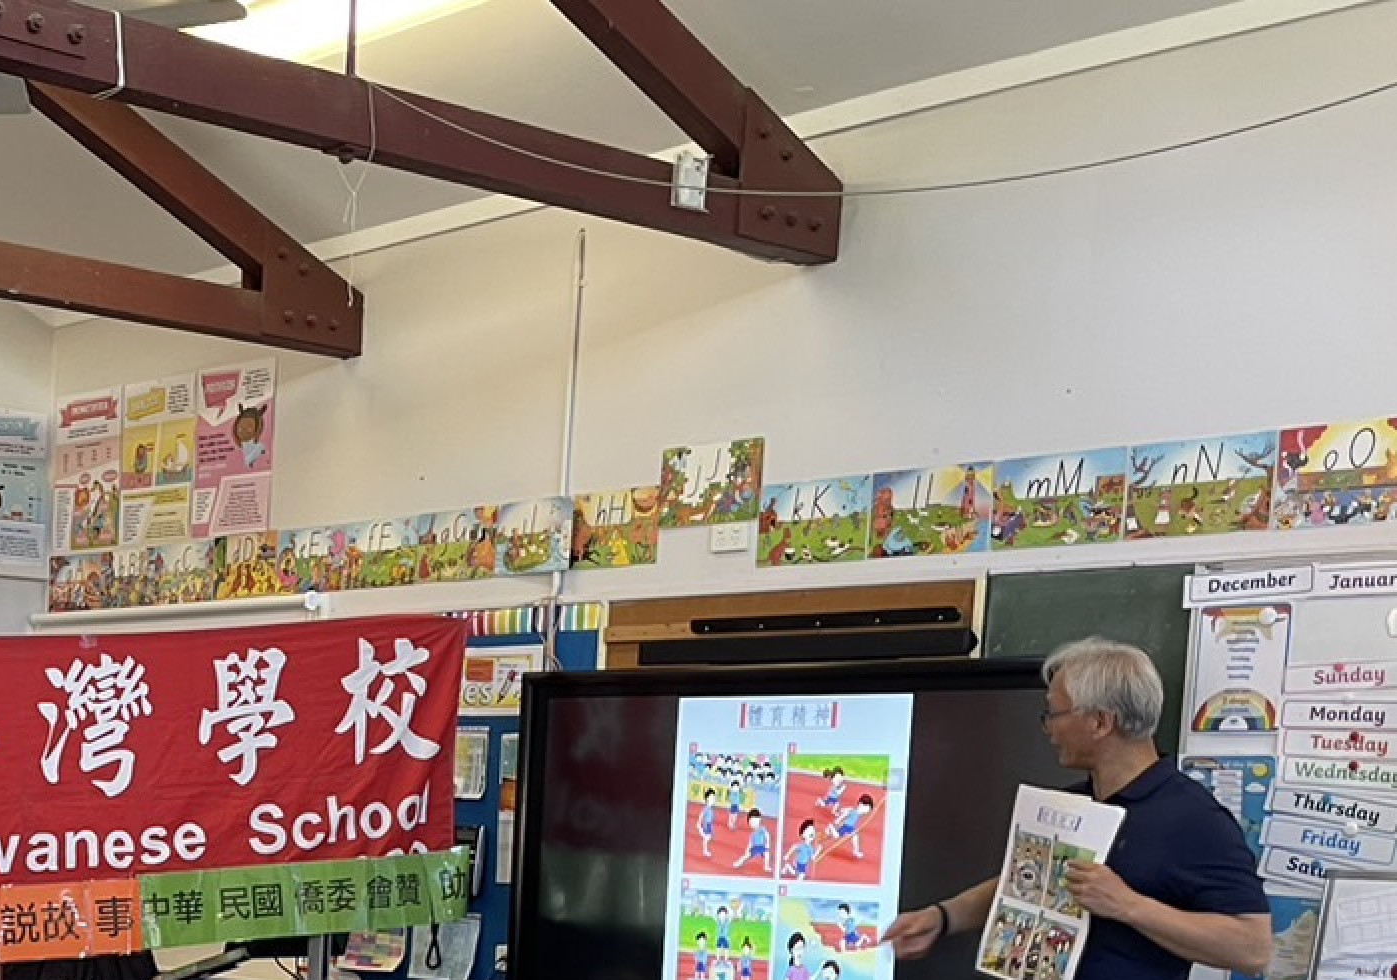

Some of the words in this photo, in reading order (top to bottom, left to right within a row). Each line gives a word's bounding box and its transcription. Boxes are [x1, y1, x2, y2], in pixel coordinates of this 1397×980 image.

[1026, 458, 1085, 499] mM
[1171, 442, 1224, 484] nN
[595, 492, 629, 524] hH
[791, 484, 831, 523] kK
[1208, 572, 1296, 592] December
[1313, 666, 1385, 686] Sunday
[1309, 706, 1385, 726] Monday
[1311, 734, 1389, 756] Tuesday
[248, 779, 430, 855] School
[1293, 792, 1380, 827] Thursday
[1301, 829, 1361, 856] Friday
